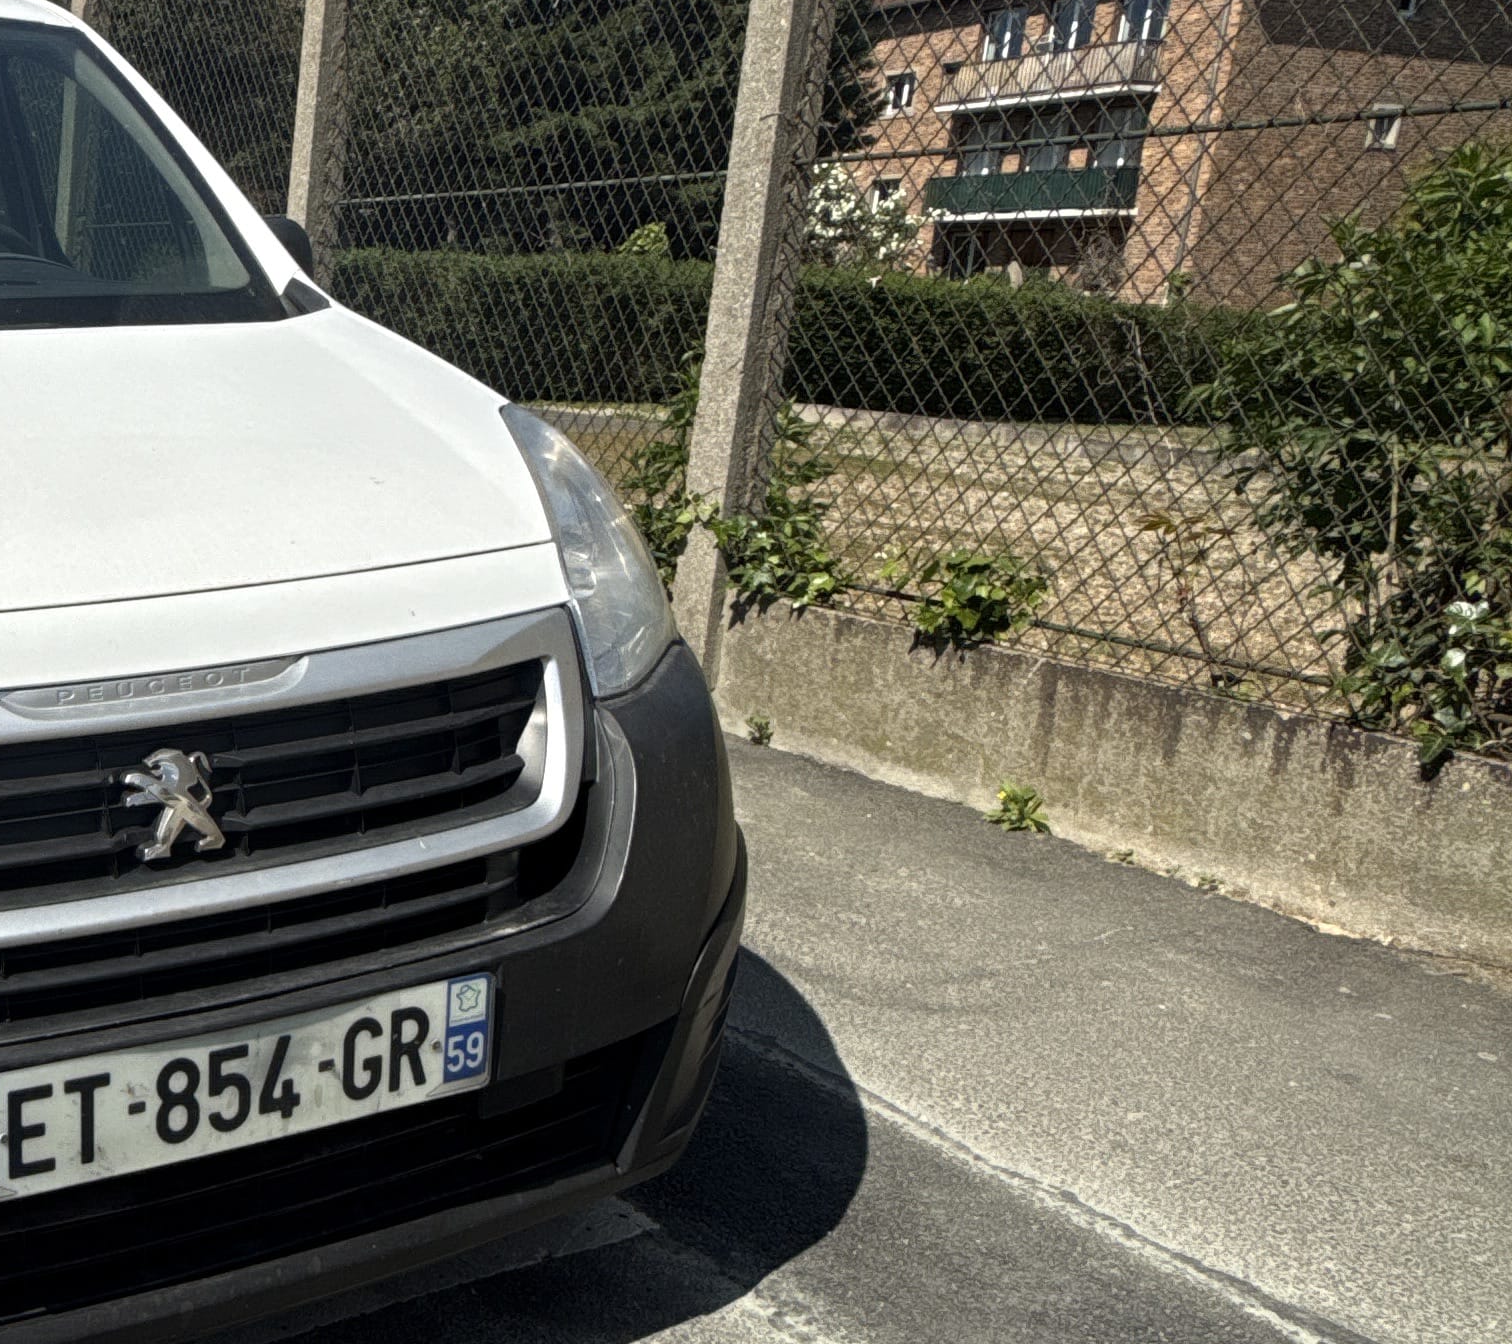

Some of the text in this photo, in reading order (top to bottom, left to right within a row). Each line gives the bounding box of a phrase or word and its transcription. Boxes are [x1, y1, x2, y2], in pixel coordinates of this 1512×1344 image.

[56, 667, 250, 705] PEUGEOT
[447, 1031, 485, 1072] 59
[7, 1006, 430, 1180] ET-854-GR
